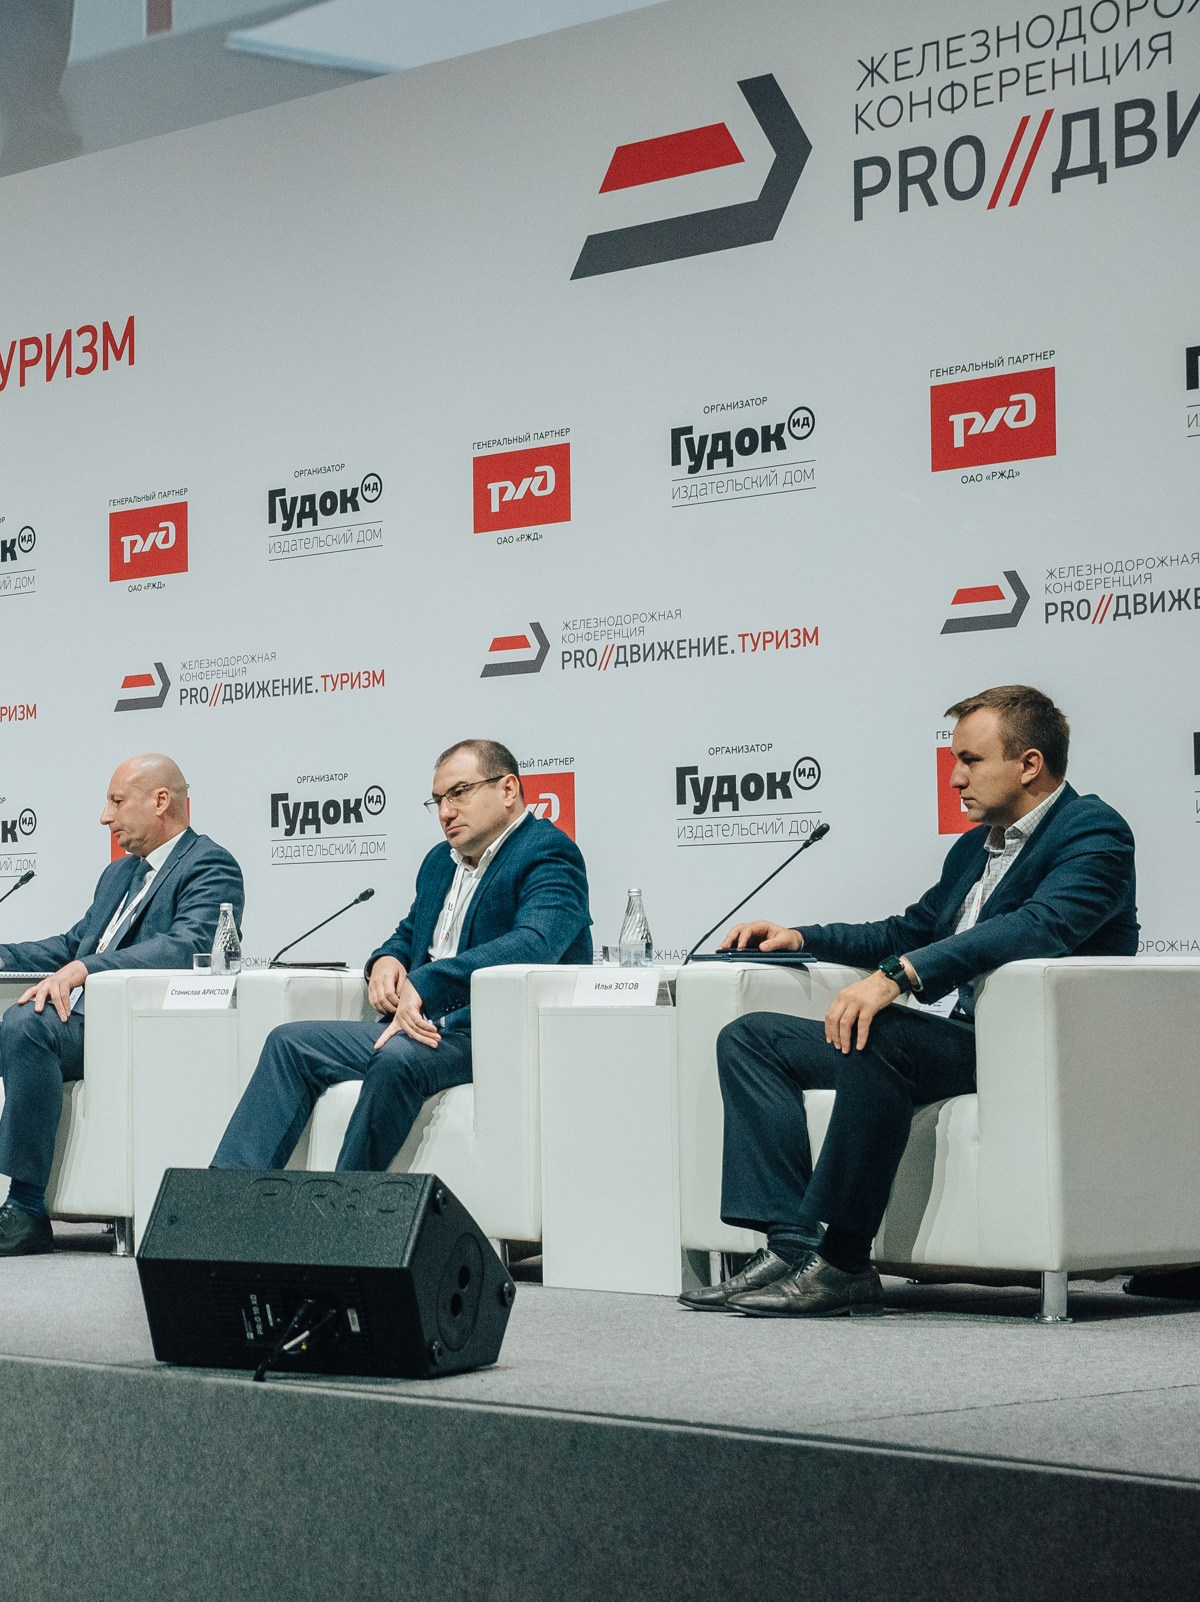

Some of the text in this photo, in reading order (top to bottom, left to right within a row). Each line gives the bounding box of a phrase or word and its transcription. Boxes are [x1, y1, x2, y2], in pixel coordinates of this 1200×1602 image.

[856, 0, 1200, 91] ЖЕЛЕЗНОДОРО
[855, 31, 1172, 135] КОНФЕРЕНЦИЯ
[930, 350, 1055, 378] ГЕНЕРАЛЬНЫЙ ПАРТНЕР
[703, 397, 767, 414] ОРГАНИЗАТОР
[473, 428, 570, 450] ГЕНЕРАЛЬНЫЙ ПАРТНЕР
[671, 422, 787, 475] Гудок
[294, 464, 345, 478] ОРГАНИЗАТОР
[961, 469, 1020, 484] ОАО «РЖД»
[109, 488, 188, 507] ГЕНЕРАЛЬНЫЙ ПАРТНЕР
[268, 486, 360, 532] Гудок
[497, 532, 543, 545] ОАО «РЖД»
[1046, 552, 1200, 580] ЖЕЛЕЗНОДОРОЖНАЯ
[128, 581, 165, 592] ОАО «РЖД»
[1045, 573, 1152, 595] КОНФЕРЕНЦИЯ
[562, 609, 682, 631] ЖЕЛЕЗНОДОРОЖНАЯ
[562, 626, 645, 644] КОНФЕРЕНЦИЯ
[181, 652, 277, 670] ЖЕЛЕЗНОДОРОЖНАЯ
[180, 667, 247, 682] КОНФЕРЕНЦИЯ
[708, 743, 773, 755] ОРГАНИЗАТОР
[538, 757, 575, 767] ПАРТНЕР
[297, 773, 348, 784] ОРГАНИЗАТОР
[676, 766, 792, 815] Гудок
[271, 793, 363, 838] Гудок
[677, 818, 784, 840] издательский
[272, 840, 386, 860] издательский дом
